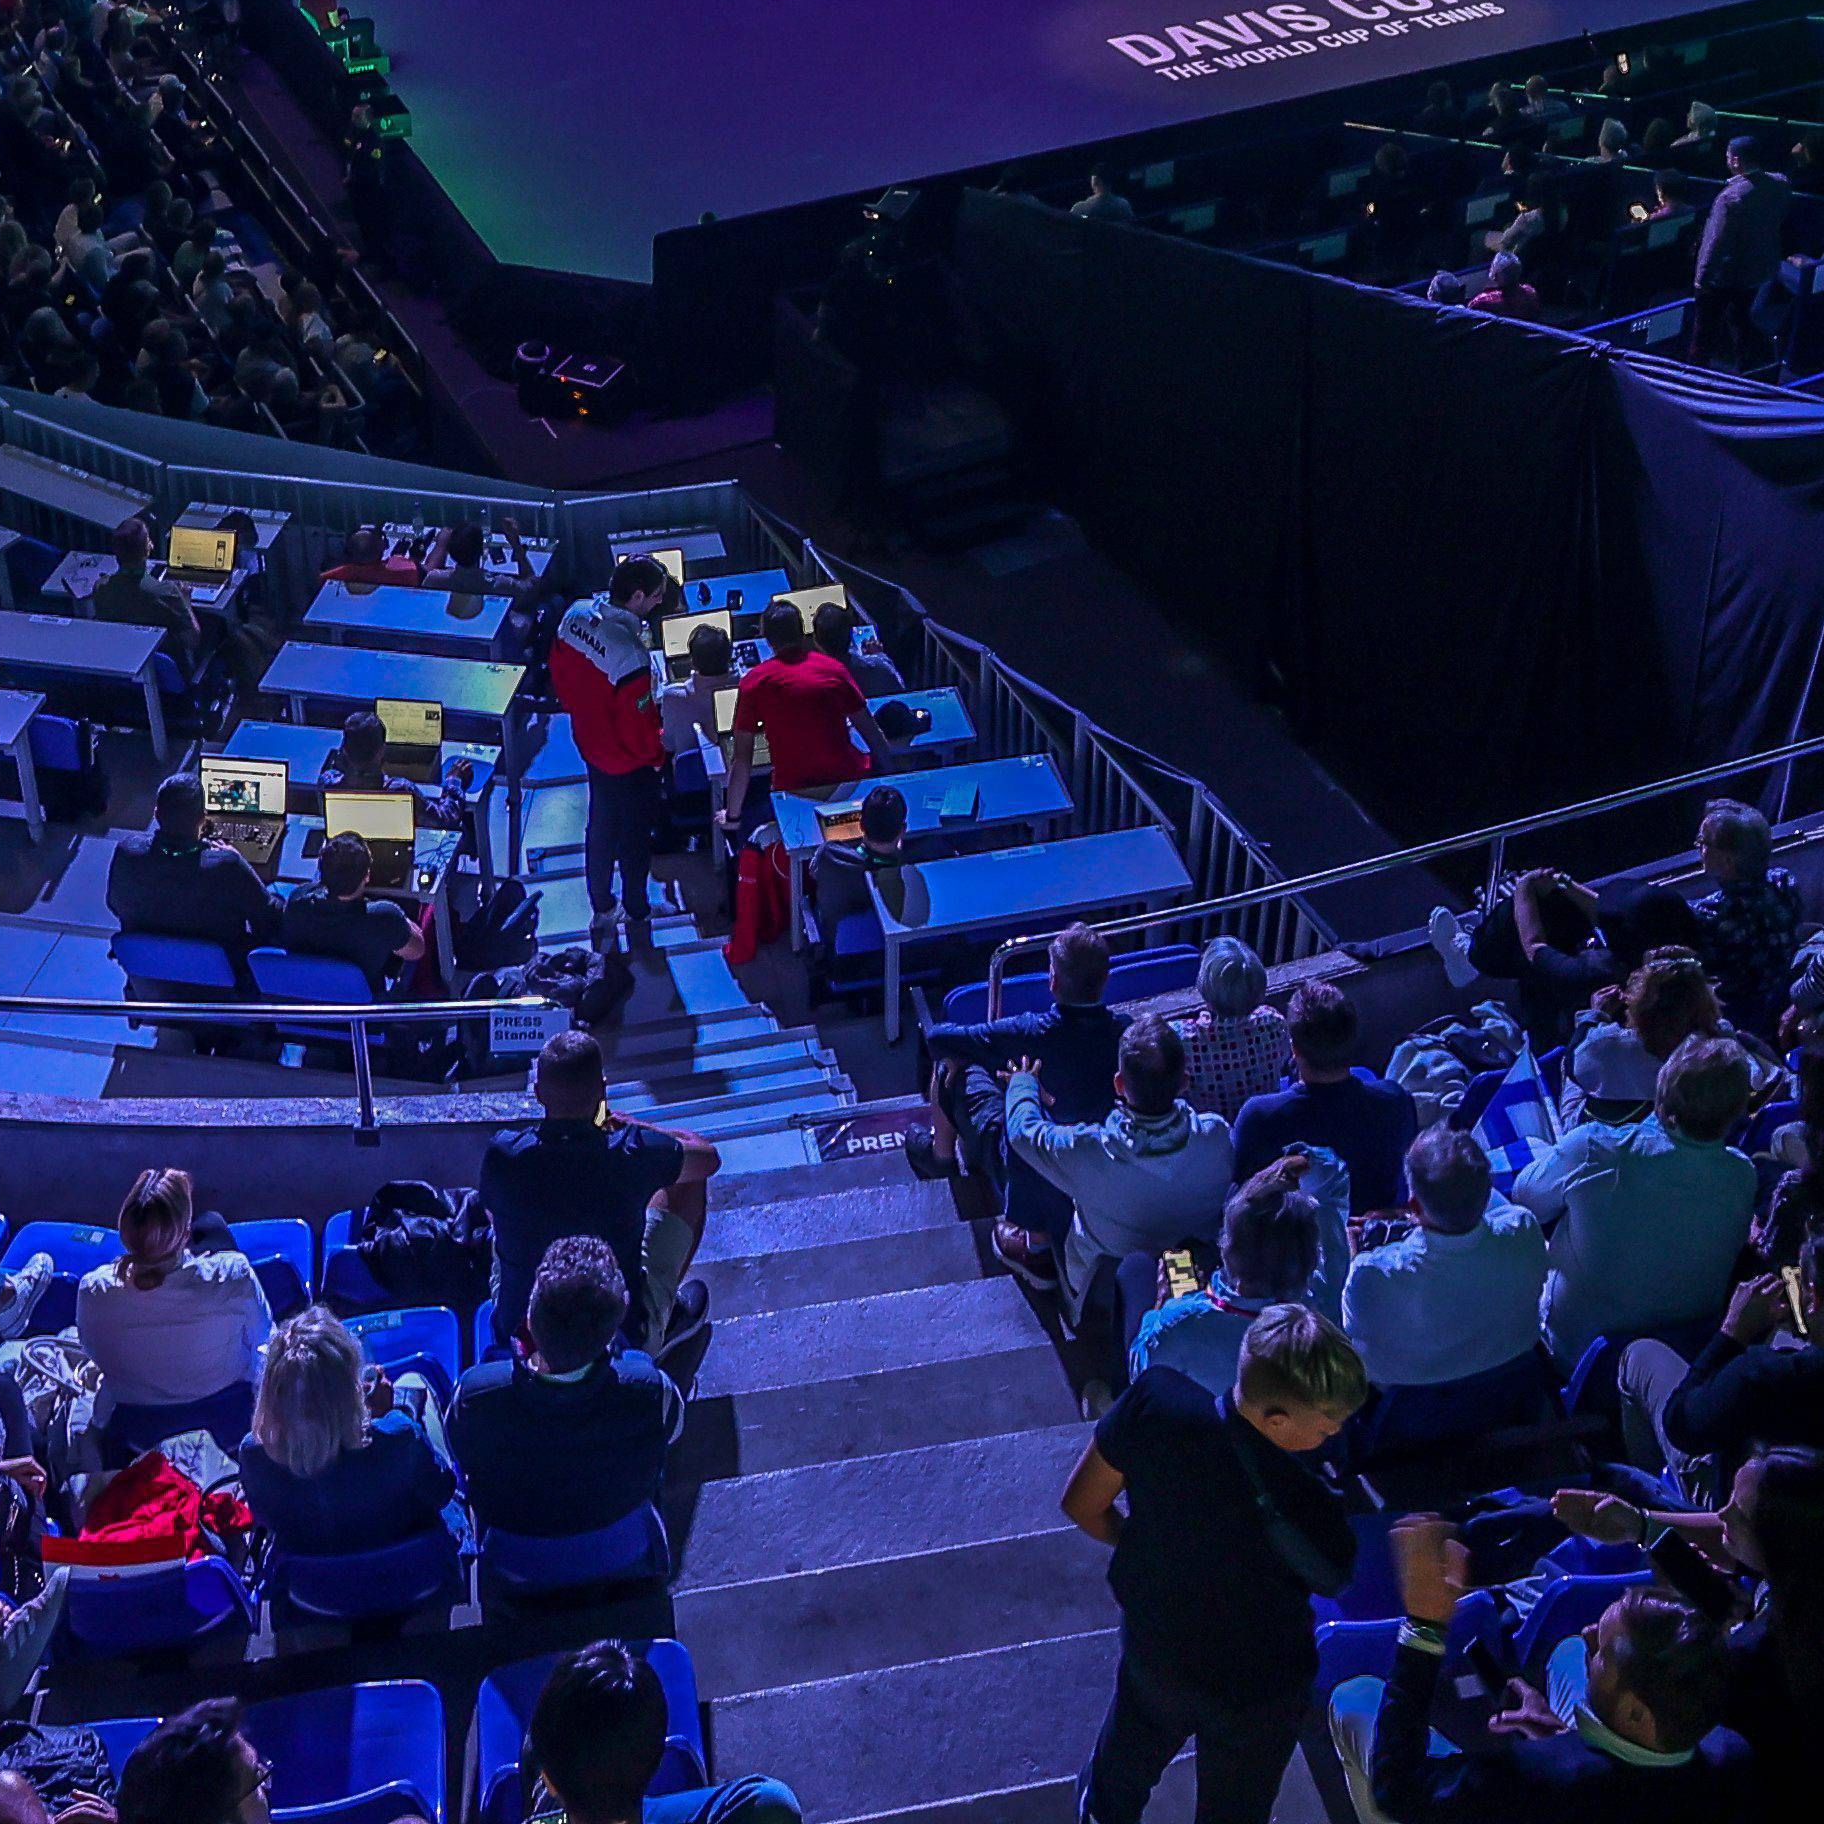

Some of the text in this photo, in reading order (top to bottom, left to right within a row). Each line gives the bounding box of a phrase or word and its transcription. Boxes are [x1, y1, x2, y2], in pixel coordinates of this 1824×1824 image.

[1107, 4, 1332, 68] DAVIS
[1154, 1, 1507, 83] THE WORLD CUP OF TENNIS
[569, 623, 608, 658] CANADA
[493, 1029, 545, 1041] Stands
[494, 1016, 543, 1028] PRESS
